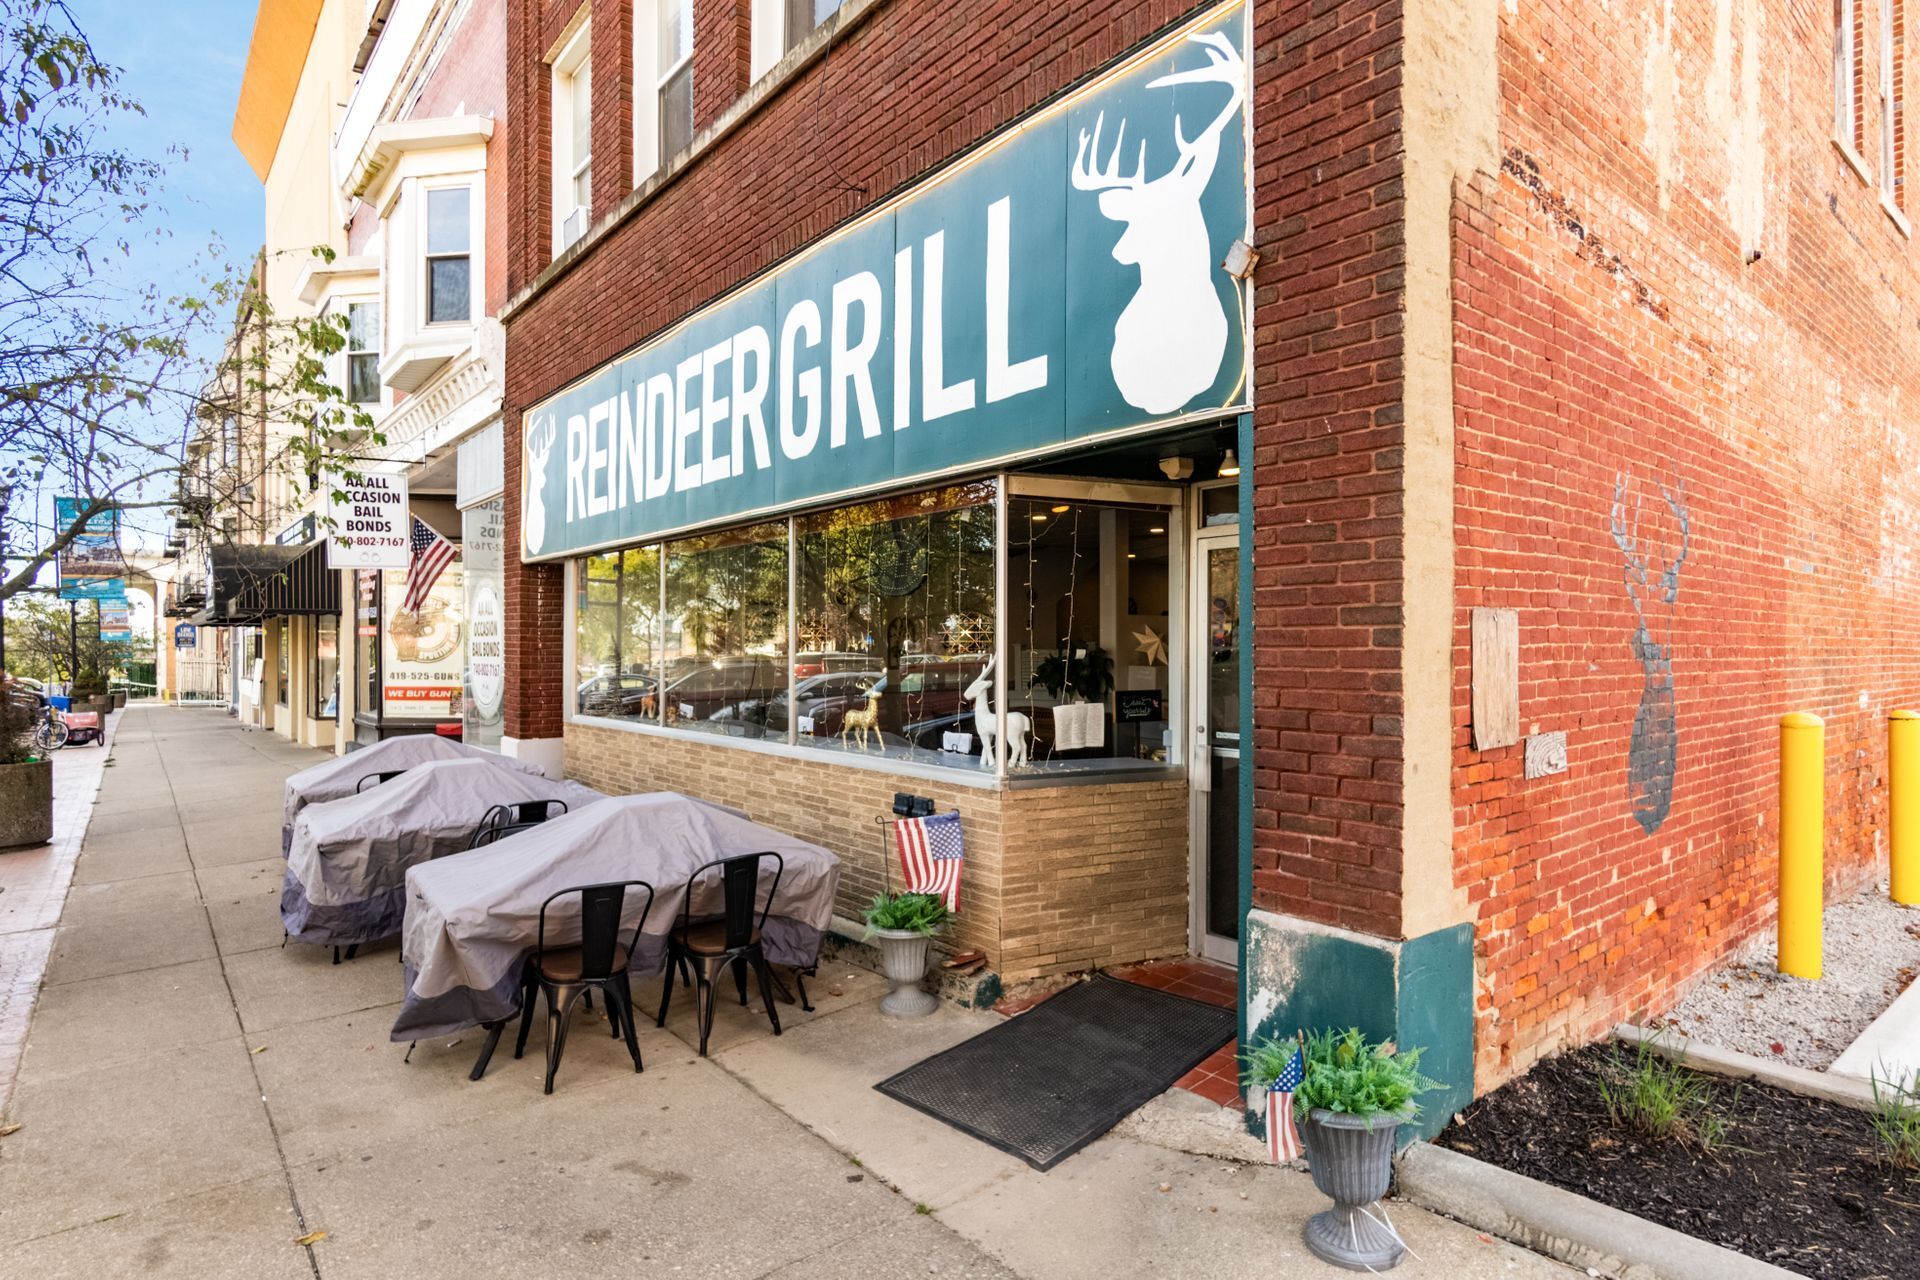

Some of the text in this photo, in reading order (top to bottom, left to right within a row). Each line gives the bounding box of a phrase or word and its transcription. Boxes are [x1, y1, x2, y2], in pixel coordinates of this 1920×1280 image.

[566, 195, 1048, 523] REINDEER GRILL
[366, 477, 389, 489] ALL
[338, 491, 401, 503] CCASION
[354, 506, 383, 518] BAIL
[346, 520, 392, 532] BONDS
[474, 620, 498, 637] OCCASION
[472, 641, 500, 656] BAIL BONDS
[388, 689, 452, 698] WE BUY GUN
